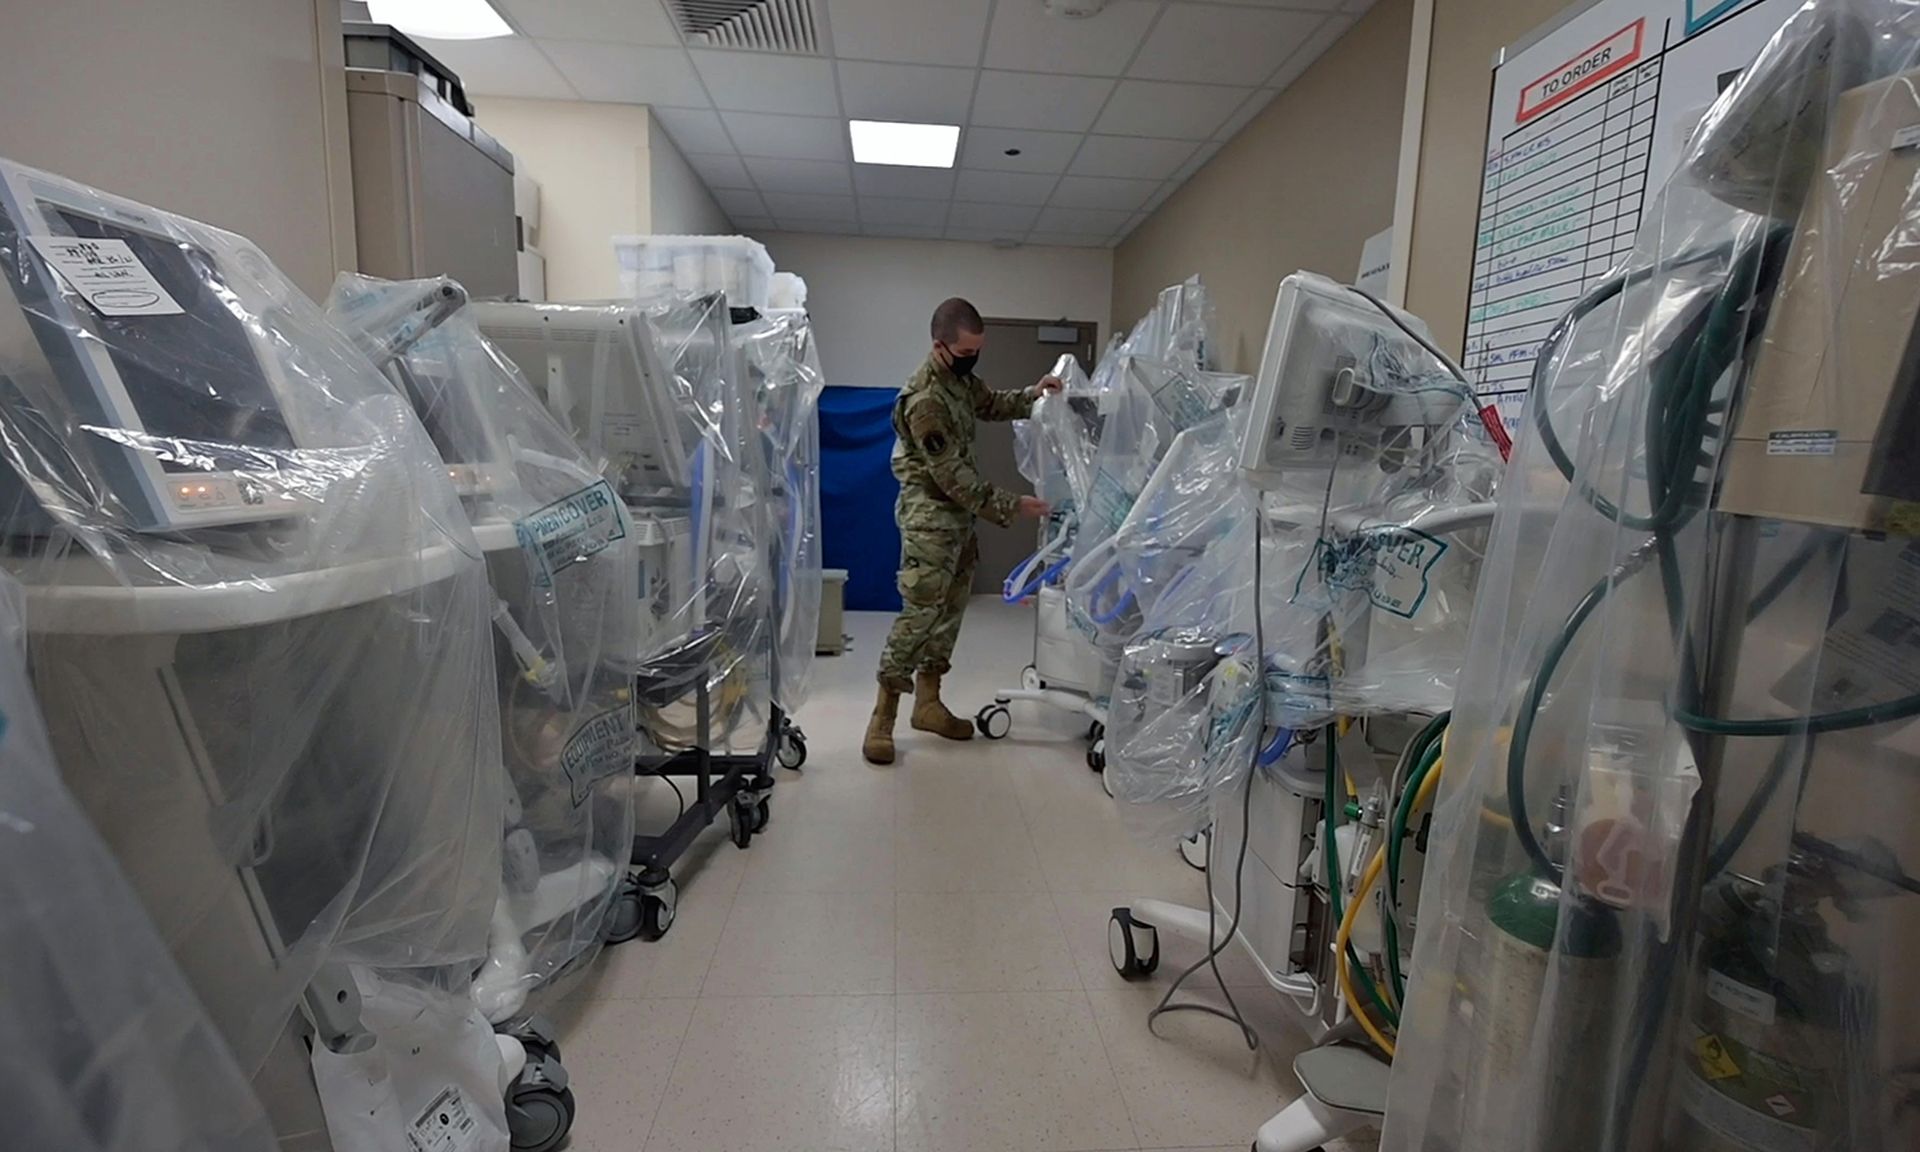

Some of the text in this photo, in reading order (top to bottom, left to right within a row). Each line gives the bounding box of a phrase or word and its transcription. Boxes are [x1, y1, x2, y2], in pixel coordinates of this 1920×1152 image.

[1542, 79, 1559, 98] TO
[1562, 47, 1612, 86] ORDER
[559, 489, 608, 524] COVER
